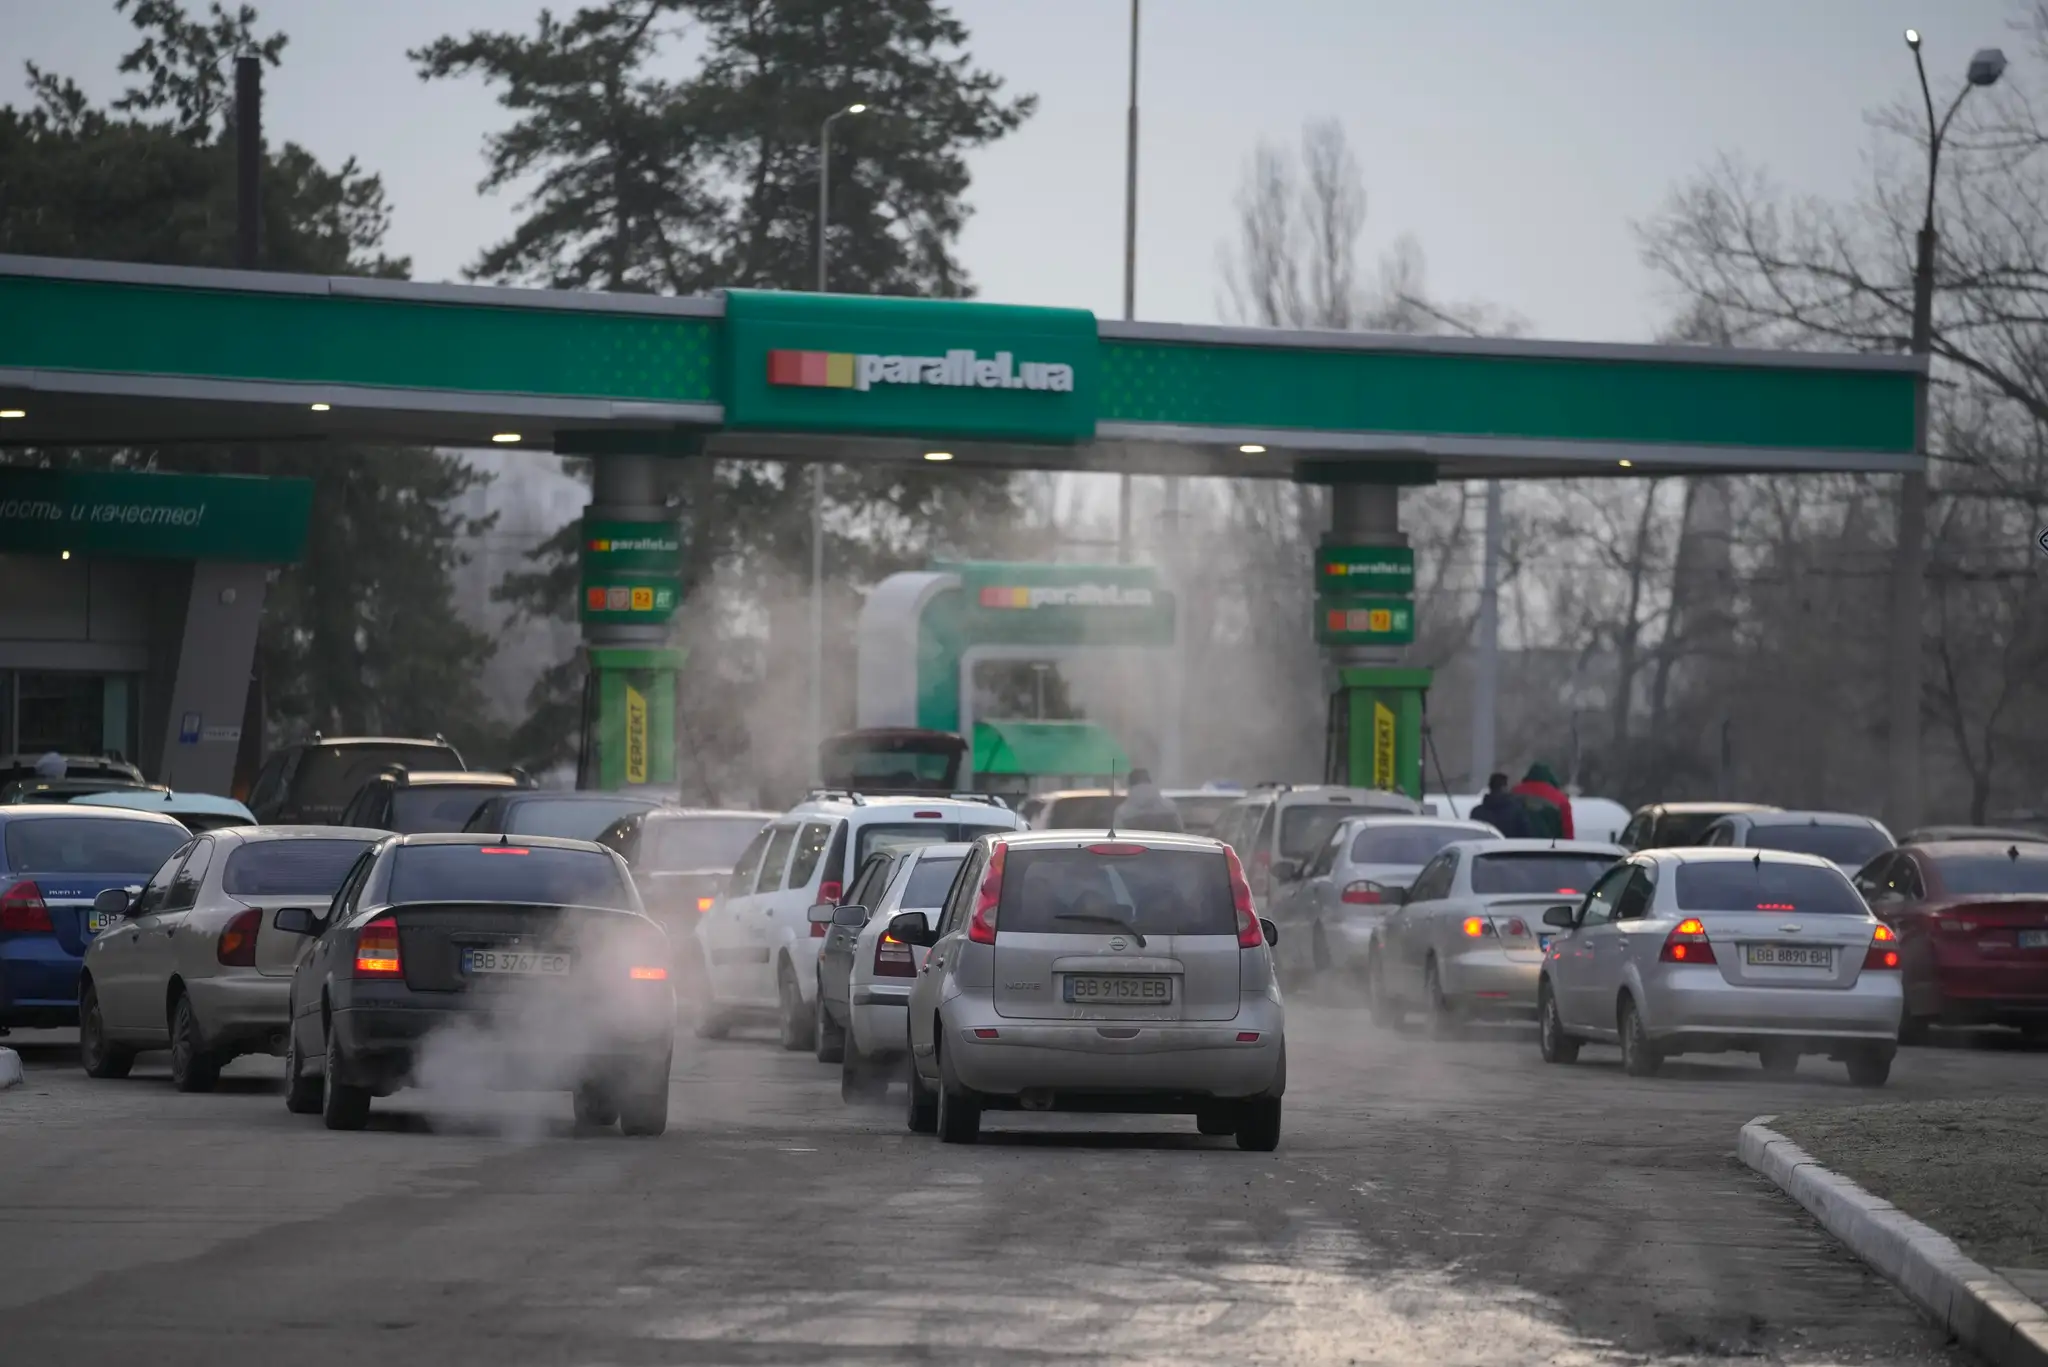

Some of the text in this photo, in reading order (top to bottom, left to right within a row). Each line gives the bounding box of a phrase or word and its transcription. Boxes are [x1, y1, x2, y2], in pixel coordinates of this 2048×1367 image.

[855, 349, 1074, 392] parallel.ua
[70, 503, 85, 521] и
[90, 502, 206, 527] качество!
[611, 537, 679, 552] parallel.ua
[473, 952, 496, 969] BB
[501, 954, 538, 971] 3767
[1756, 948, 1774, 962] BB
[1075, 980, 1166, 998] BB 9152 EB
